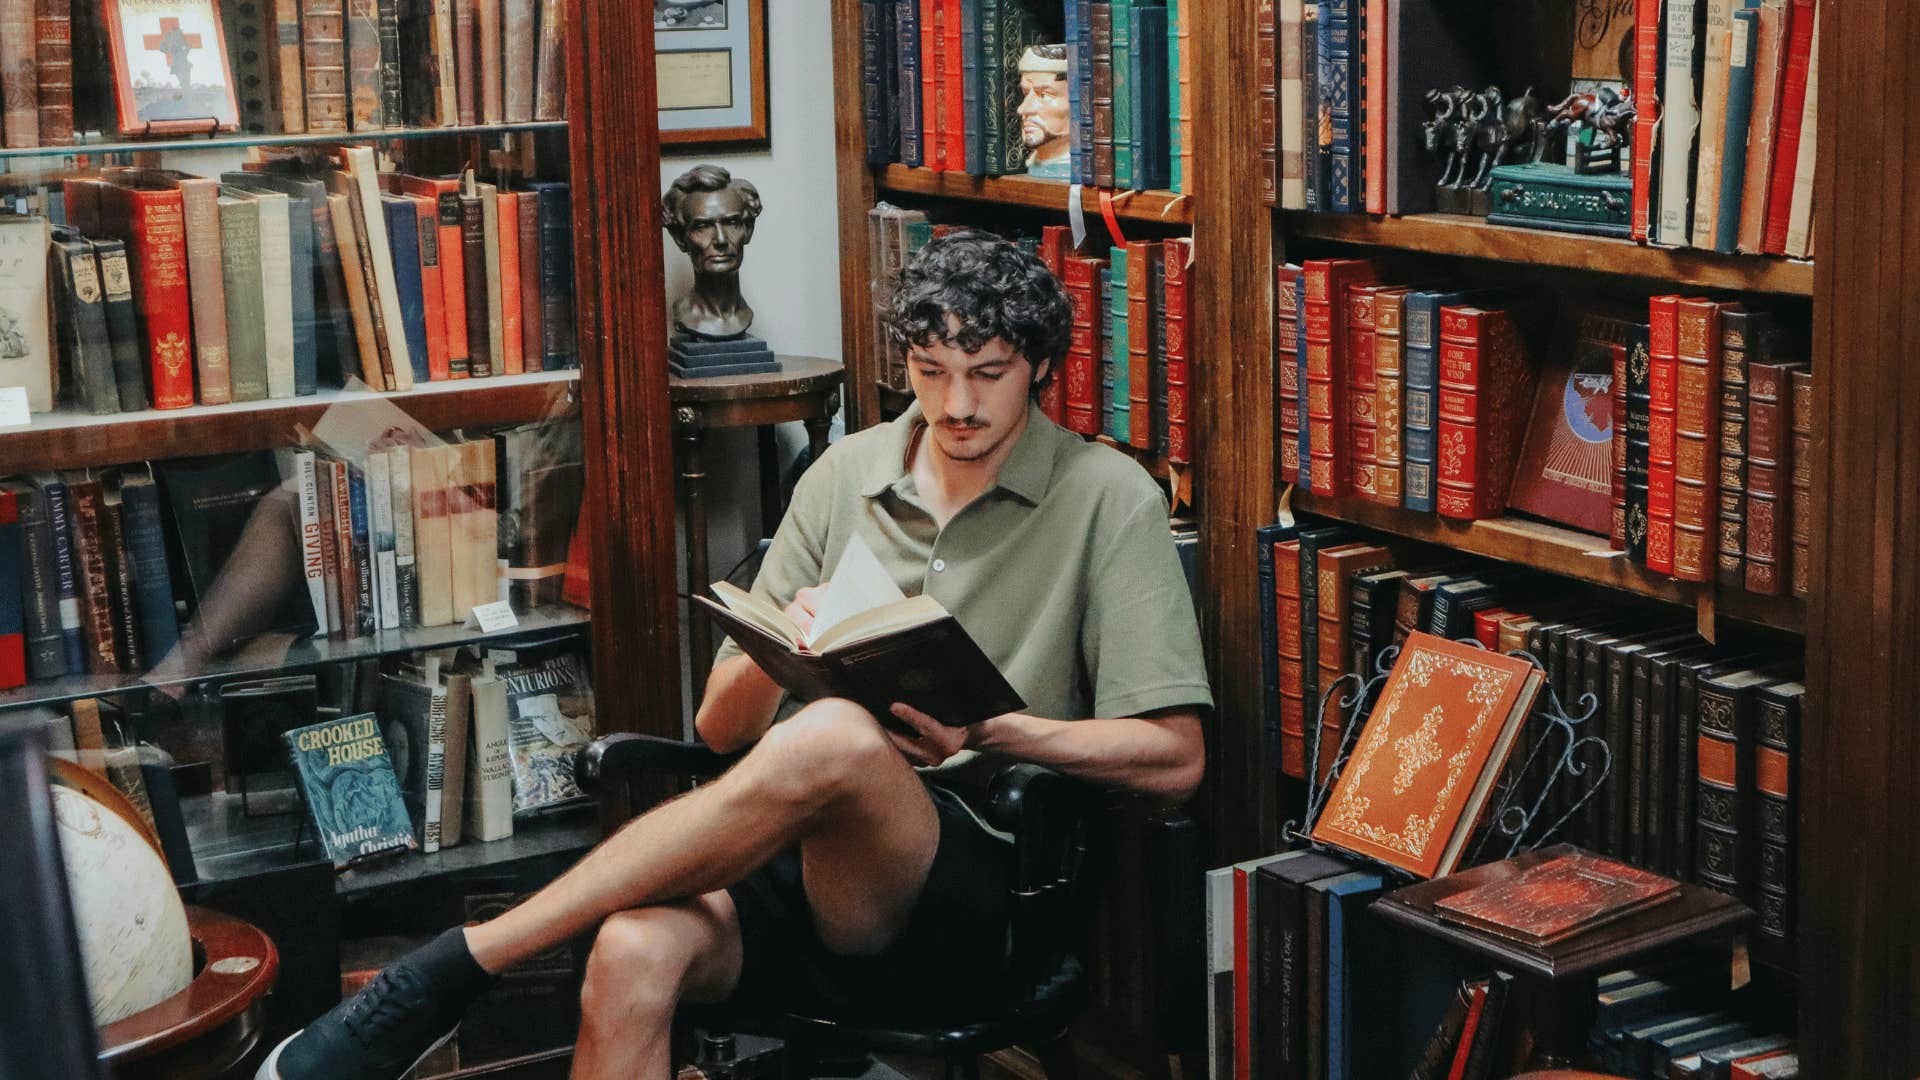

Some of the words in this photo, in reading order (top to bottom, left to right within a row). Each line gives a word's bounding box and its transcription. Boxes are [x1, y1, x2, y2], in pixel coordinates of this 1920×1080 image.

[1448, 350, 1464, 360] GONE
[1458, 361, 1472, 372] THE
[1447, 369, 1465, 380] WIND
[304, 461, 313, 479] BILL
[51, 490, 69, 531] JIMMY
[305, 483, 315, 517] CLINTON
[57, 536, 74, 590] CARTER
[305, 522, 323, 579] GIVING
[298, 718, 375, 752] CROOKED
[430, 695, 447, 744] SURFACING
[328, 737, 385, 767] HOUSE
[428, 752, 444, 791] ATWOOD
[330, 825, 378, 849] Agatha
[360, 833, 414, 856] Christie
